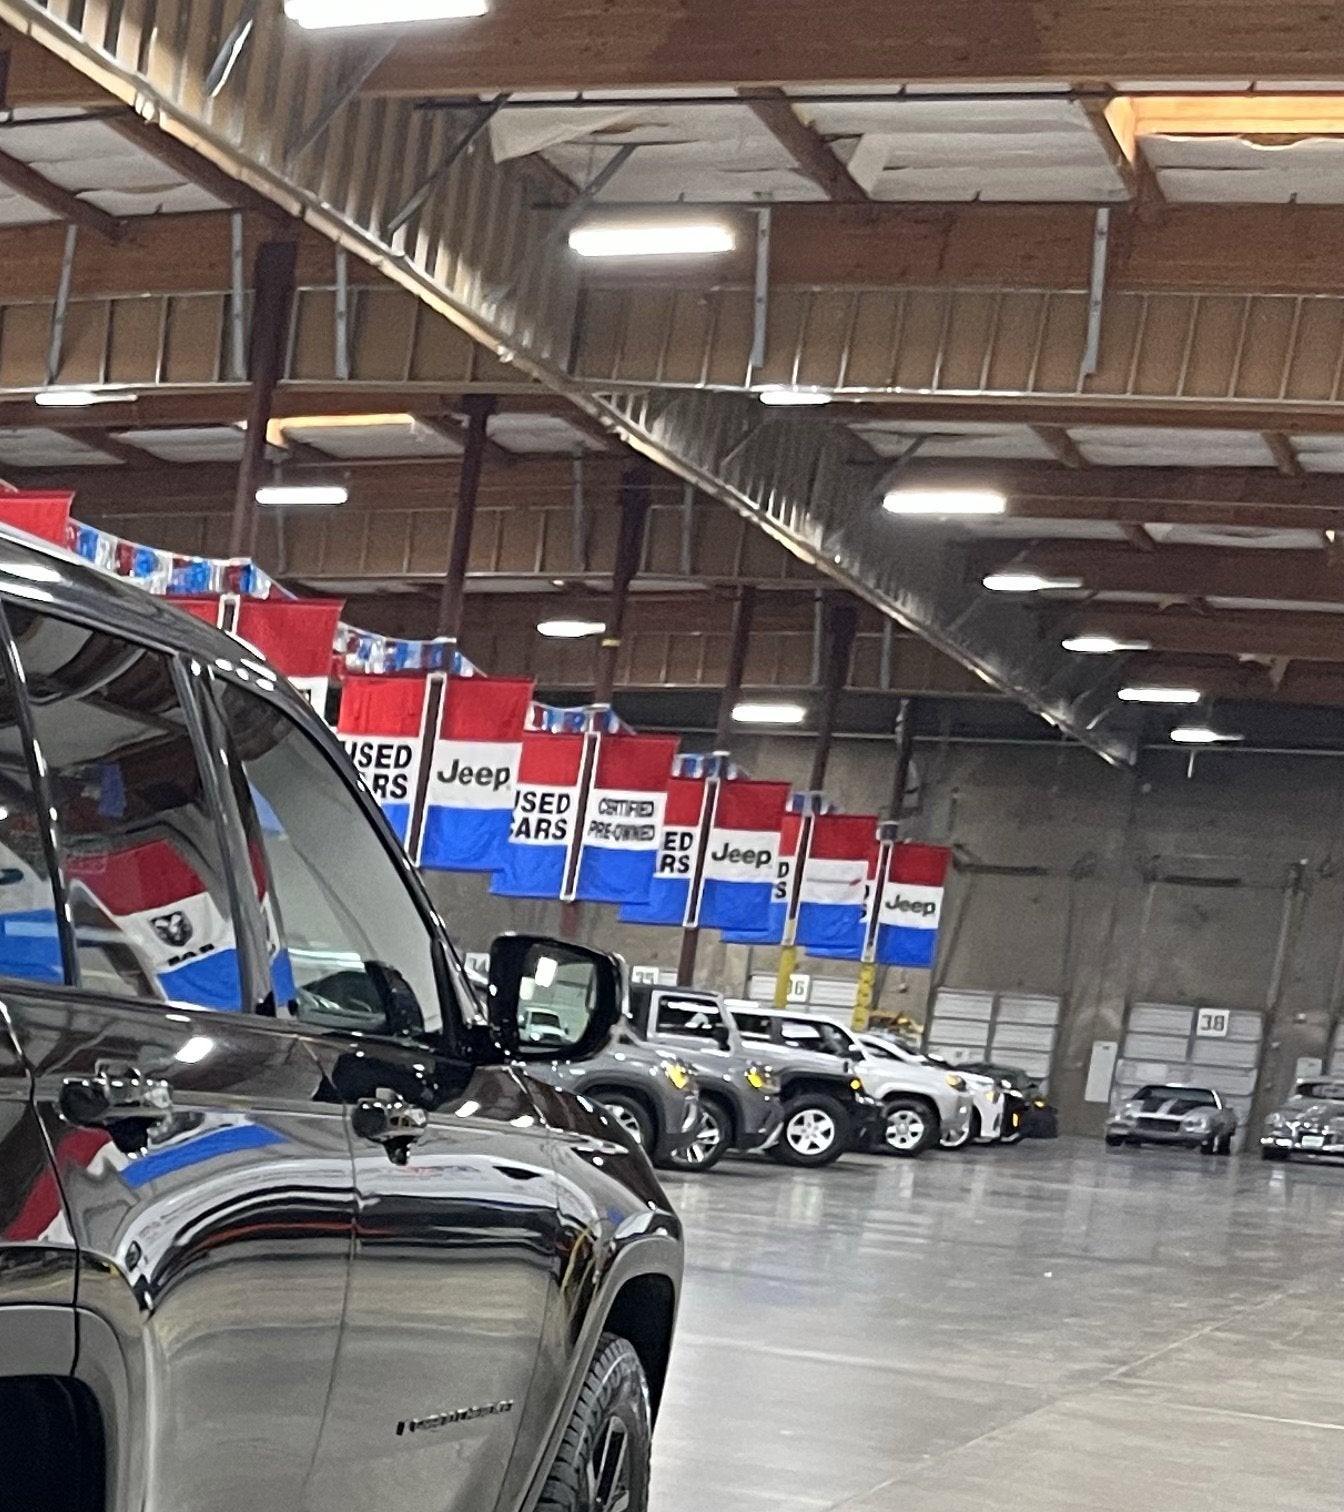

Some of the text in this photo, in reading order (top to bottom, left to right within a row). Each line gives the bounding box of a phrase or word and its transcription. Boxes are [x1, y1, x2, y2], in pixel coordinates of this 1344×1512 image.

[372, 773, 408, 799] RS
[437, 759, 511, 791] Jeep
[510, 817, 567, 840] ARS
[711, 842, 772, 869] Jeep
[885, 894, 936, 917] Jeep
[1200, 1014, 1224, 1031] 38
